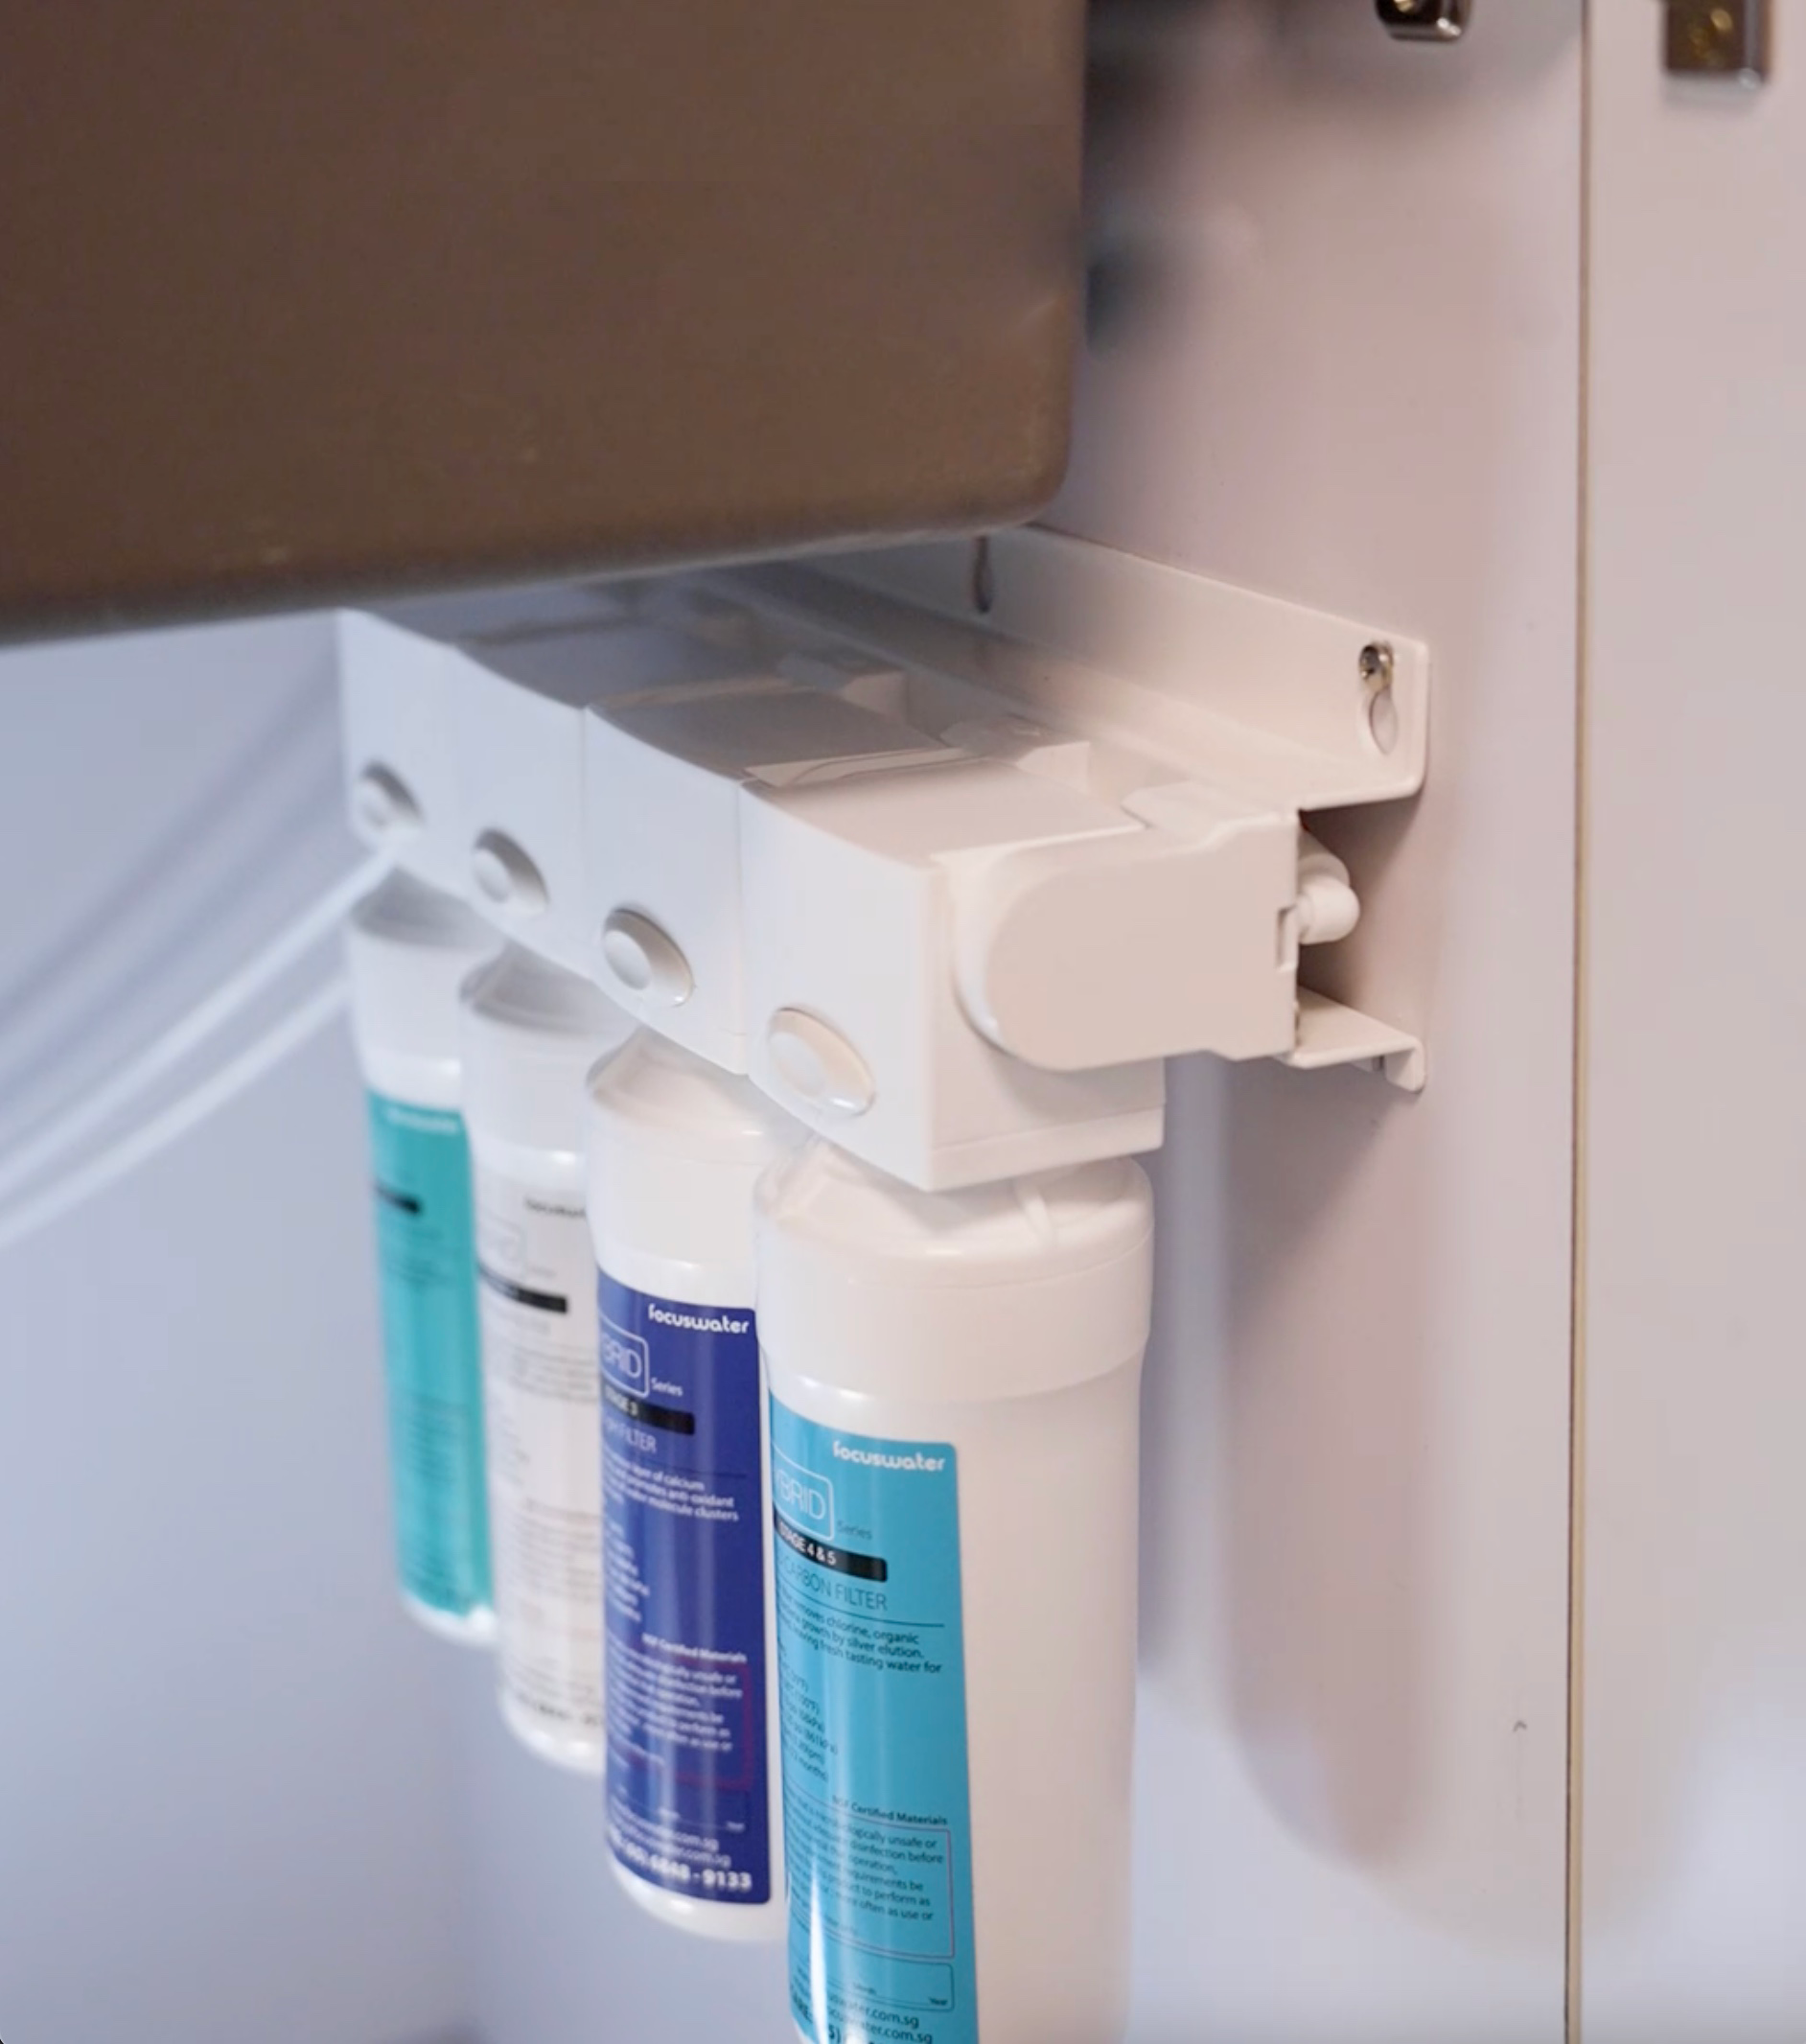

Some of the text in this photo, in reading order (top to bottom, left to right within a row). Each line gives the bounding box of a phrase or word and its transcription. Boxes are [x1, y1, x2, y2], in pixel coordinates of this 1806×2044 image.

[648, 1304, 750, 1334] focuswater
[603, 1333, 642, 1379] BRID
[651, 1378, 683, 1397] Series
[832, 1440, 946, 1473] focuswater
[653, 1471, 663, 1482] of
[664, 1474, 705, 1492] calcium
[649, 1497, 693, 1517] molecule
[695, 1506, 740, 1522] clusters
[669, 1489, 735, 1508] anti-oxidant
[837, 1520, 872, 1542] Series
[807, 1543, 816, 1557] 4
[816, 1545, 826, 1563] &
[826, 1550, 837, 1566] 5
[835, 1583, 888, 1611] FILTER
[826, 1612, 871, 1638] chlorine,
[873, 1629, 920, 1648] organic
[699, 1648, 748, 1663] Materials
[832, 1628, 845, 1646] by
[846, 1635, 876, 1653] silver
[877, 1641, 925, 1660] elution.
[845, 1649, 884, 1670] tasting
[886, 1659, 921, 1673] water
[923, 1661, 942, 1674] for
[850, 1801, 895, 1821] Certified
[896, 1812, 948, 1826] Materials
[888, 1835, 923, 1849] unsafe
[924, 1838, 938, 1849] or
[907, 1850, 944, 1864] before
[702, 1868, 752, 1891] 9133
[909, 1880, 924, 1893] be
[862, 1884, 873, 1895] to
[874, 1889, 916, 1907] perform
[918, 1896, 932, 1907] as
[859, 1899, 887, 1915] often
[888, 1907, 899, 1917] as
[900, 1909, 920, 1920] use
[921, 1912, 934, 1921] or
